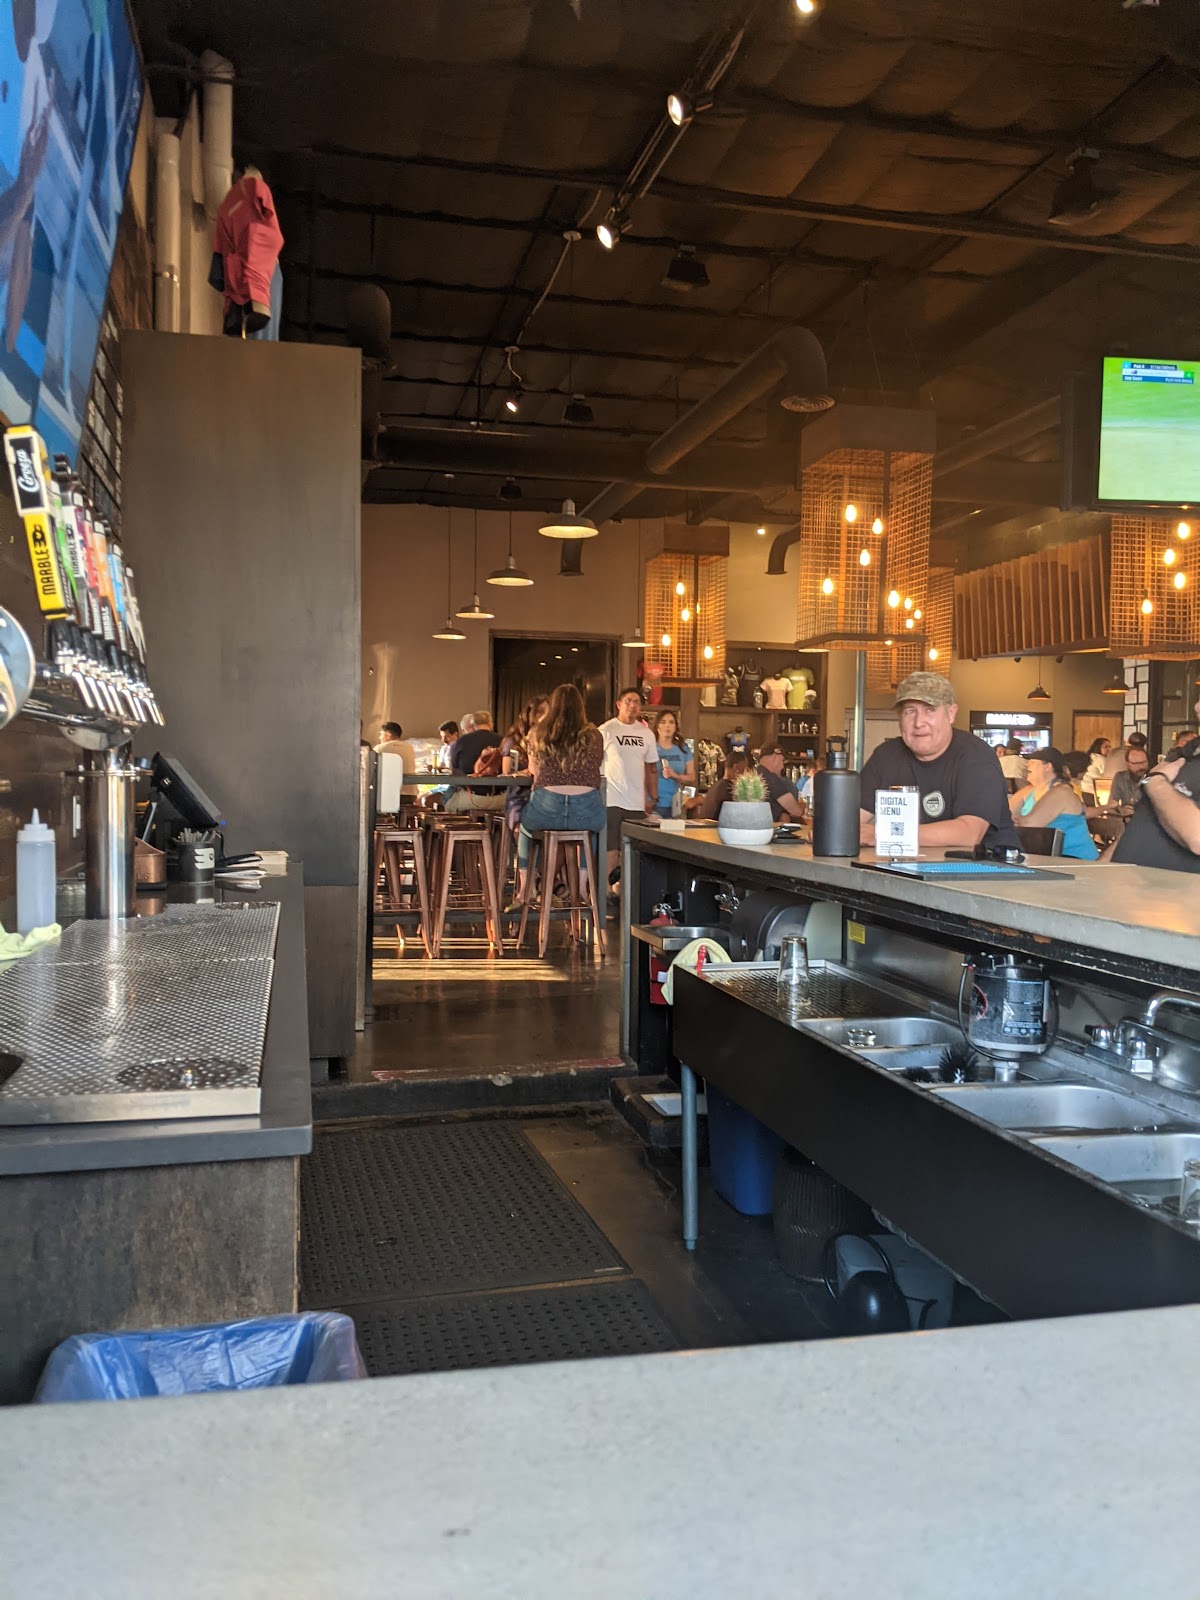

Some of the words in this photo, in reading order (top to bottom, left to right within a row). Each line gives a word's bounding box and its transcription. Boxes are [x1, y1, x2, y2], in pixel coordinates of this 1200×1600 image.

[16, 449, 40, 493] Cerveza
[35, 548, 57, 596] MARBLE
[615, 735, 644, 747] VANS
[880, 797, 907, 806] DIGITAL
[880, 807, 901, 816] MENU
